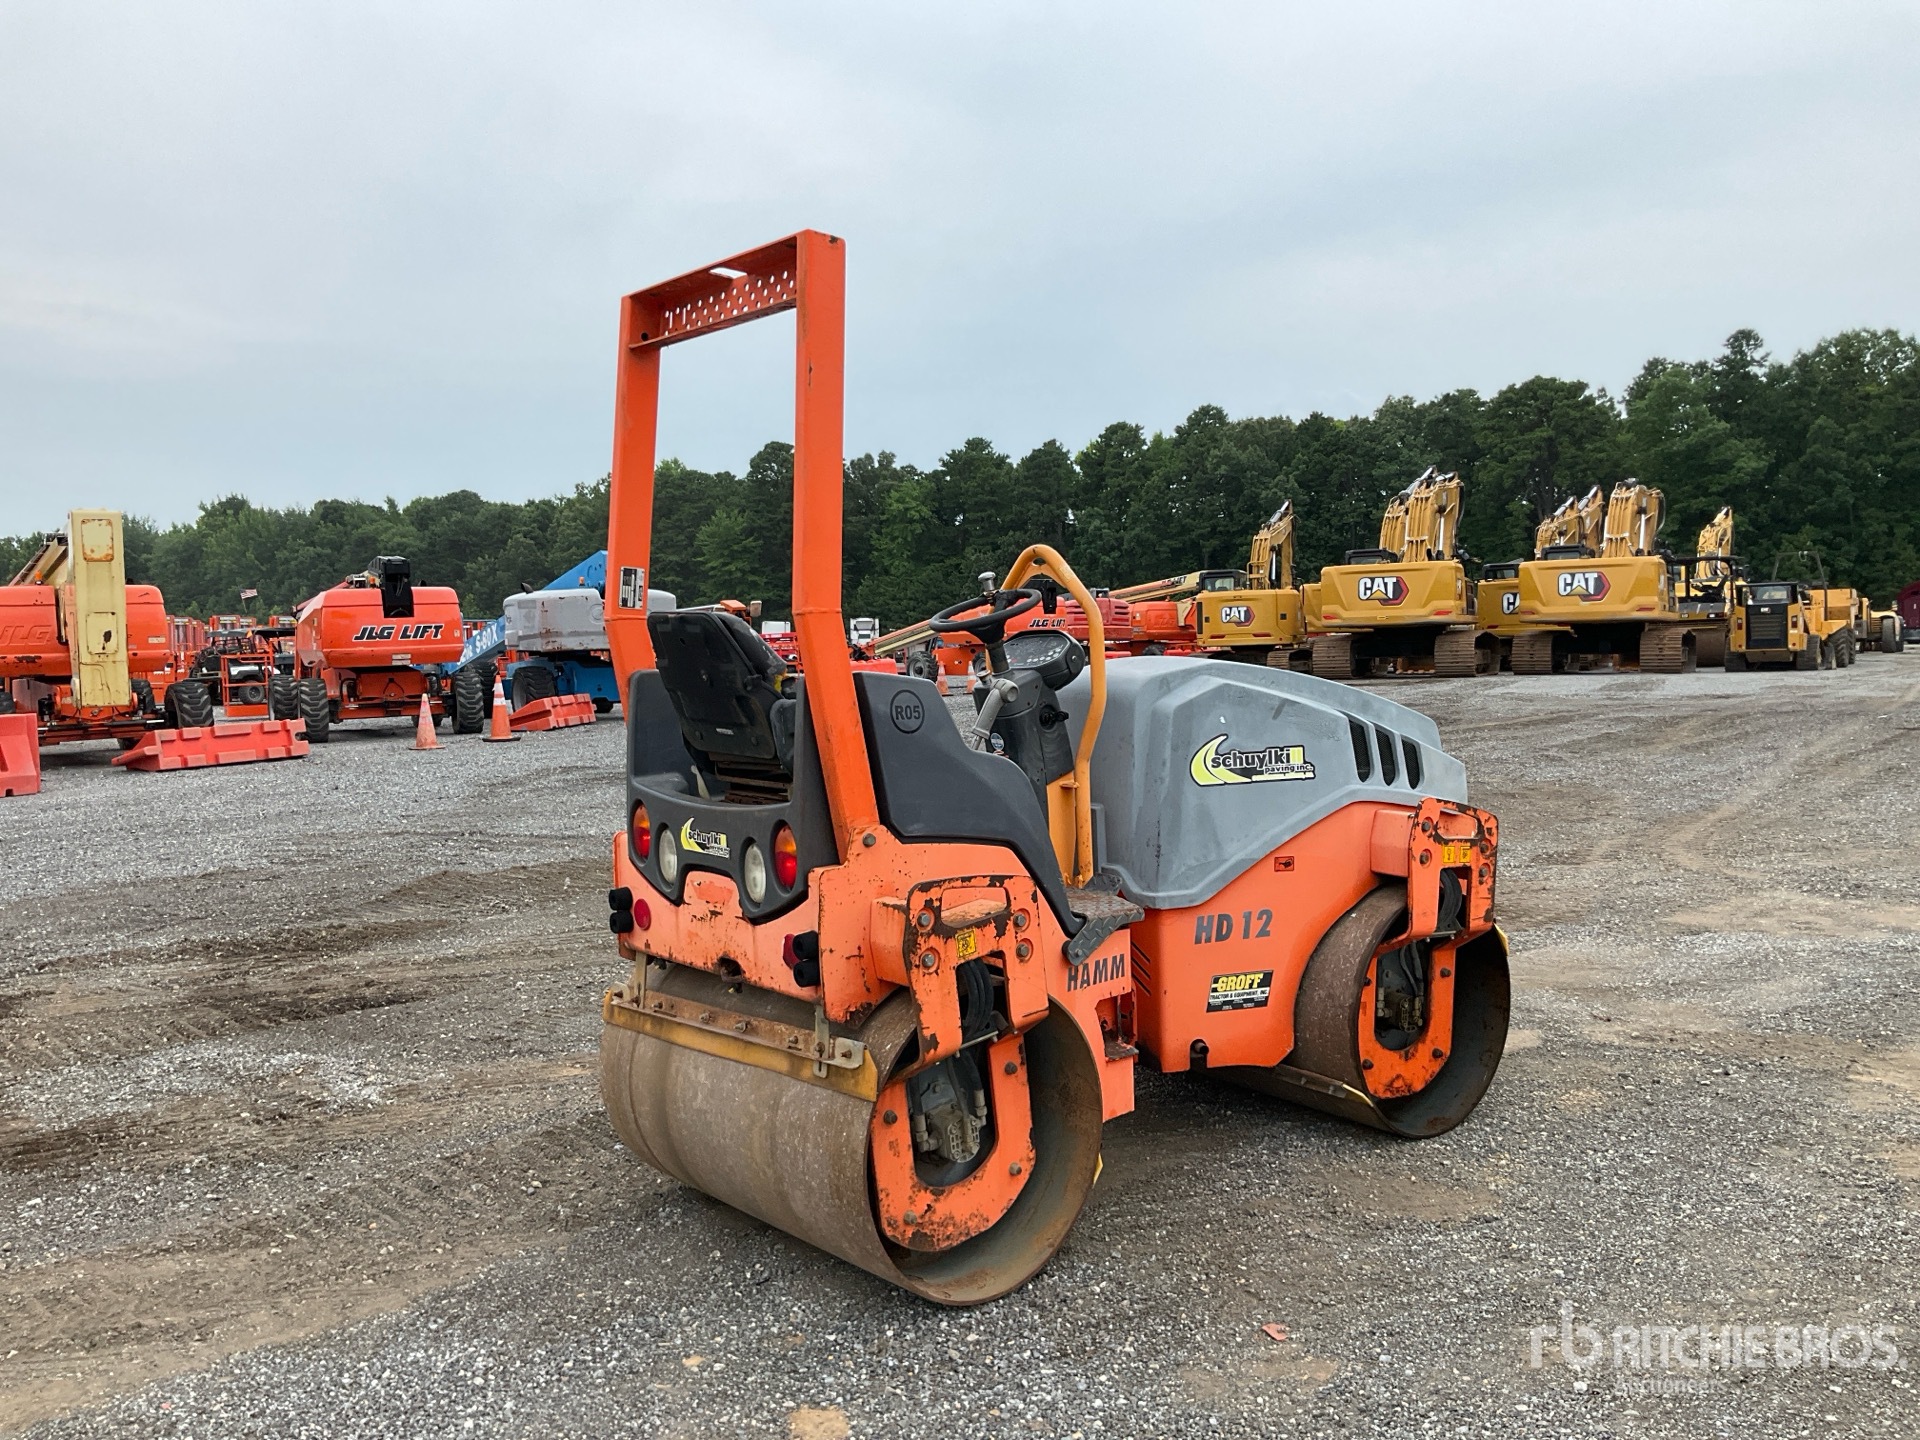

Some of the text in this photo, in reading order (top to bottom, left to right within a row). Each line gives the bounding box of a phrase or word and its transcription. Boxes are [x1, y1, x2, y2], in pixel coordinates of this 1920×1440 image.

[1359, 576, 1397, 600] CAT
[1559, 572, 1598, 596] CAT
[1028, 618, 1049, 628] JLG
[1221, 606, 1247, 623] CAT
[0, 625, 51, 646] JLG
[353, 624, 444, 641] JLG LIFT
[894, 705, 921, 721] R05
[1264, 765, 1295, 774] paving
[1194, 908, 1273, 945] HD 12
[1067, 953, 1125, 992] HAMM
[1216, 973, 1263, 992] GROFF
